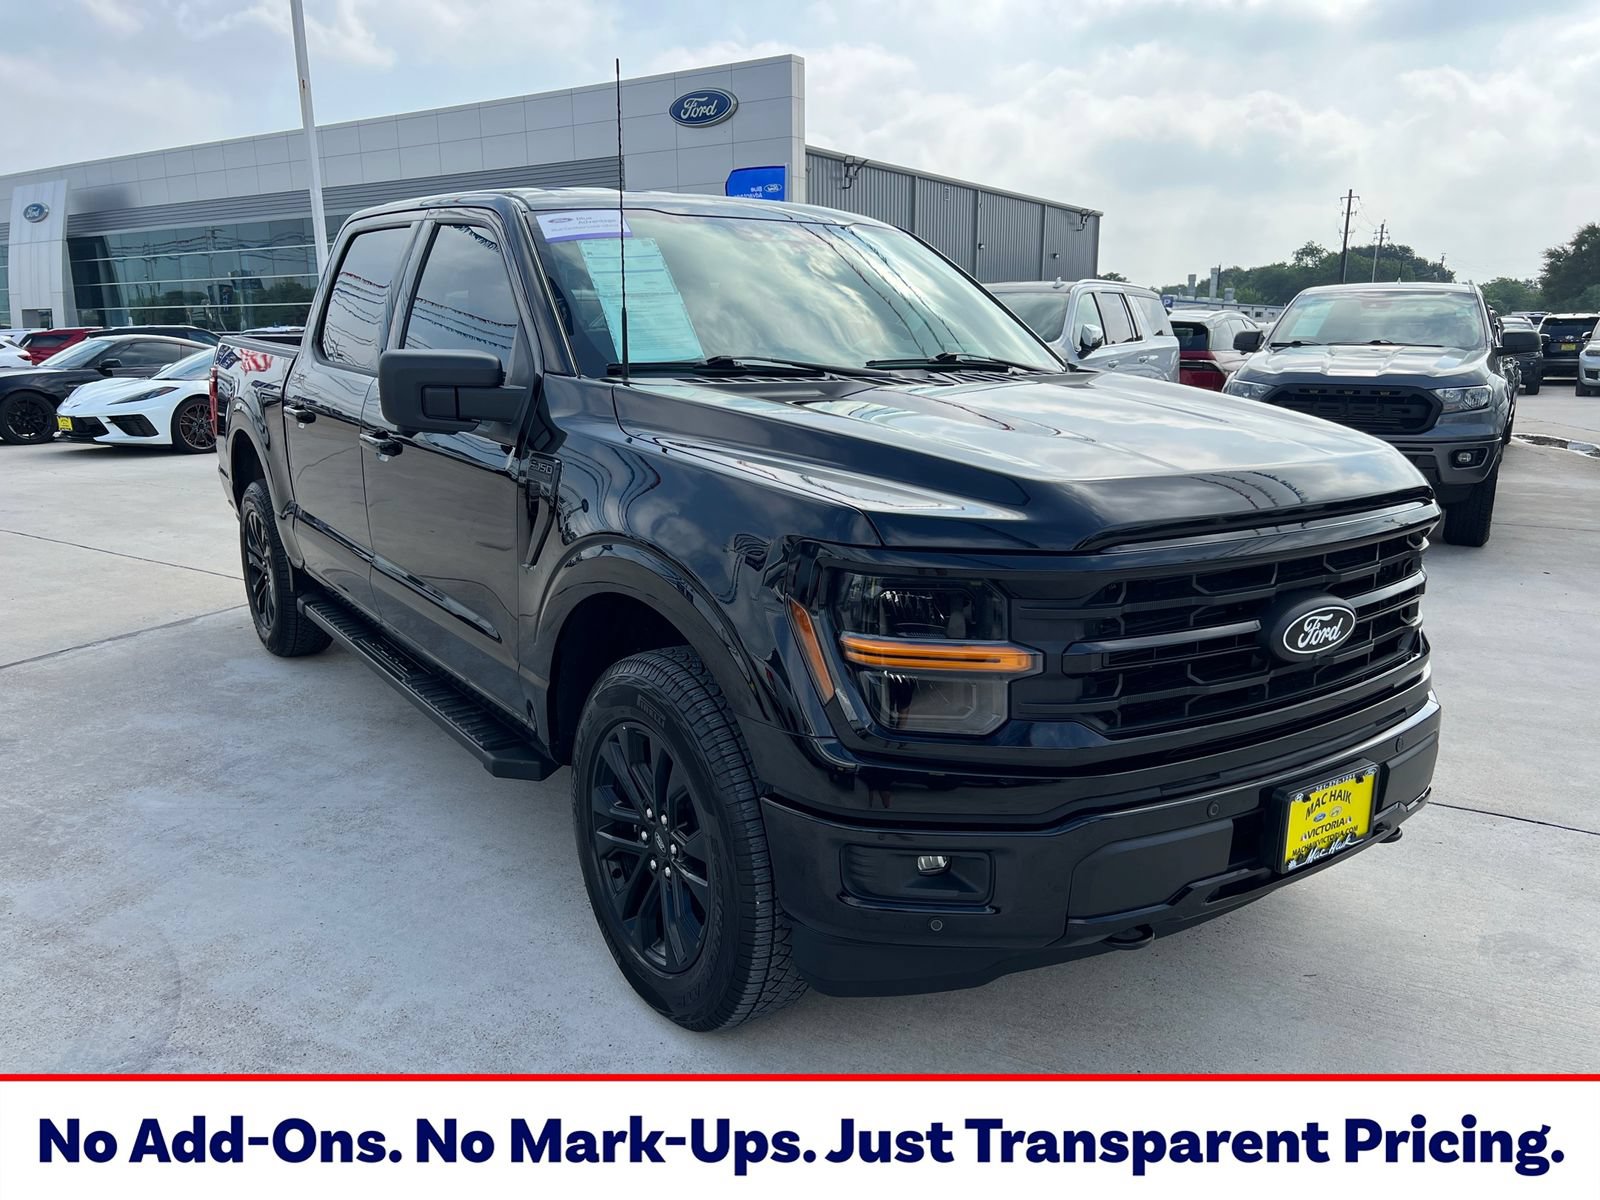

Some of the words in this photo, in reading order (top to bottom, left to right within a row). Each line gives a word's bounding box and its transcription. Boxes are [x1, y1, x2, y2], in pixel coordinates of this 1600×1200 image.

[681, 96, 718, 119] Ford
[26, 206, 41, 218] Ford
[530, 459, 553, 474] F-150
[1297, 613, 1344, 648] Ford
[1305, 792, 1328, 820] MAC
[1329, 789, 1352, 804] HAIK
[1307, 817, 1345, 839] VICTORIA
